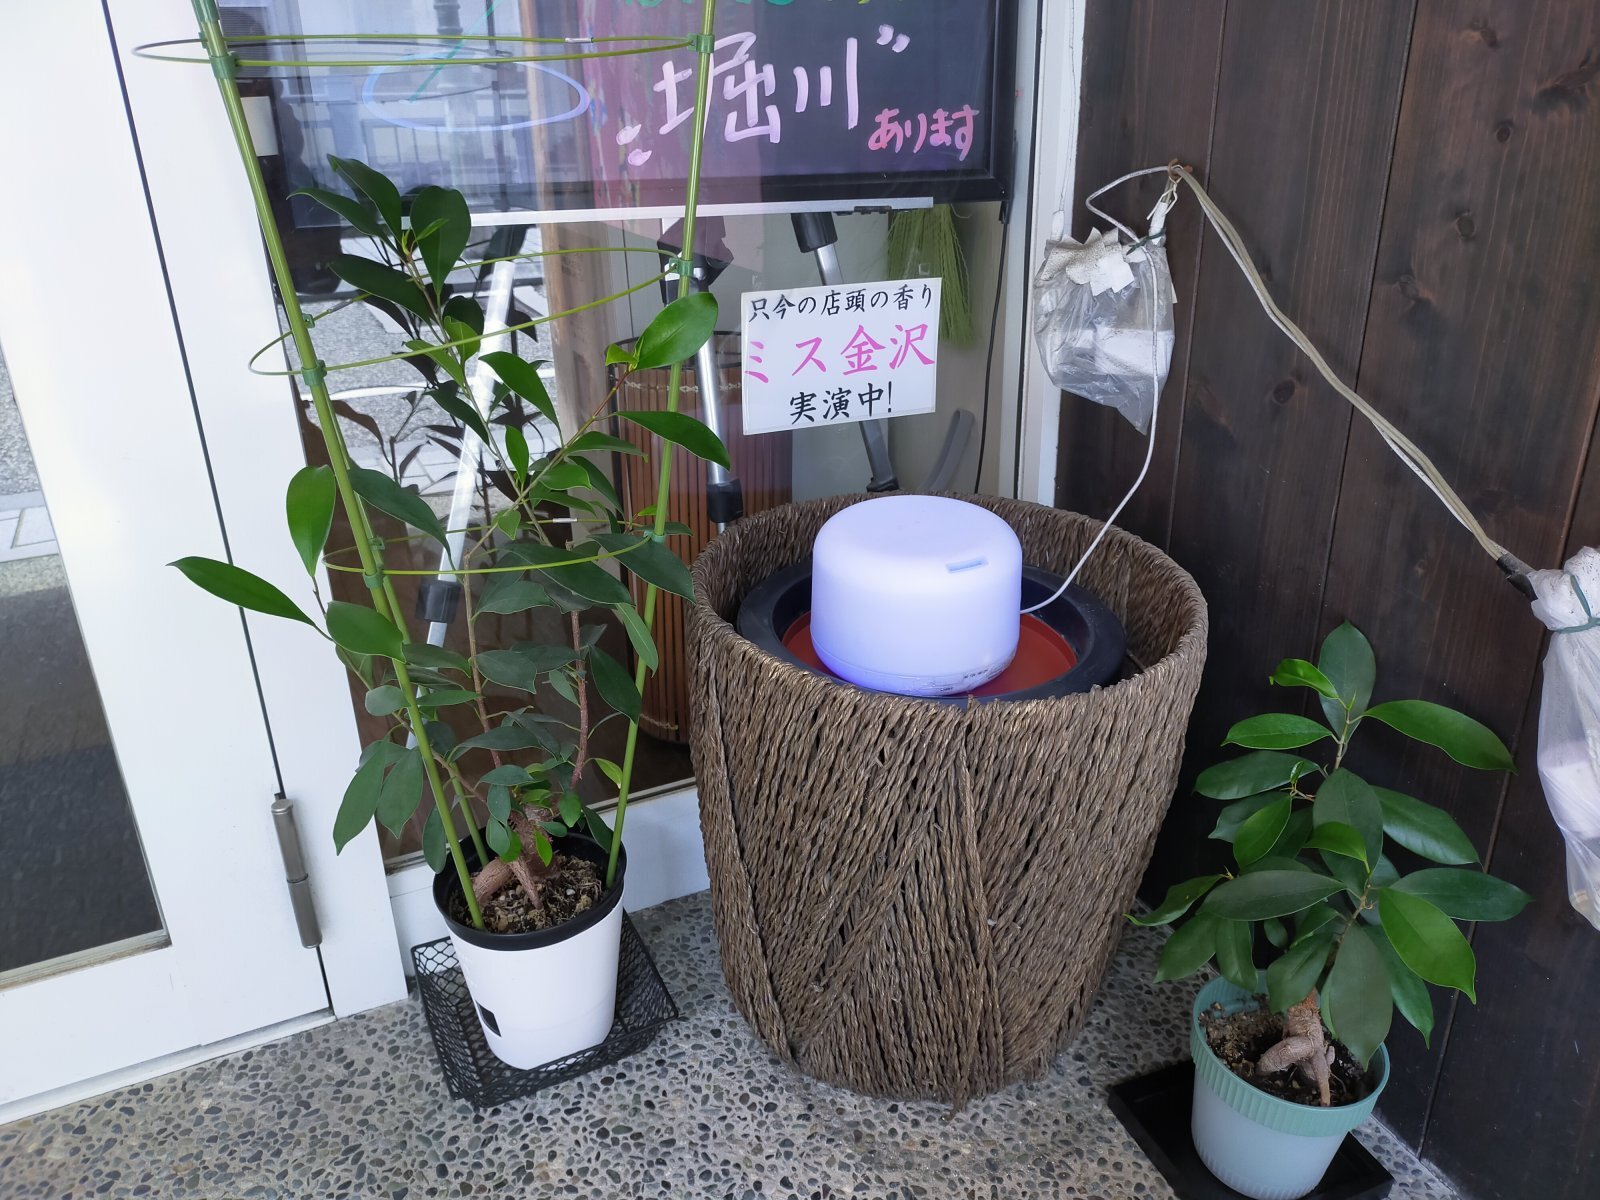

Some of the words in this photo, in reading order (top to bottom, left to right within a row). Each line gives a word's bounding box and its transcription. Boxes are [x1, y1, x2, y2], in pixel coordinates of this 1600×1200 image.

[867, 103, 980, 162] あります
[748, 283, 932, 322] 只今の店頭の香り
[744, 323, 936, 384] ミス金沢
